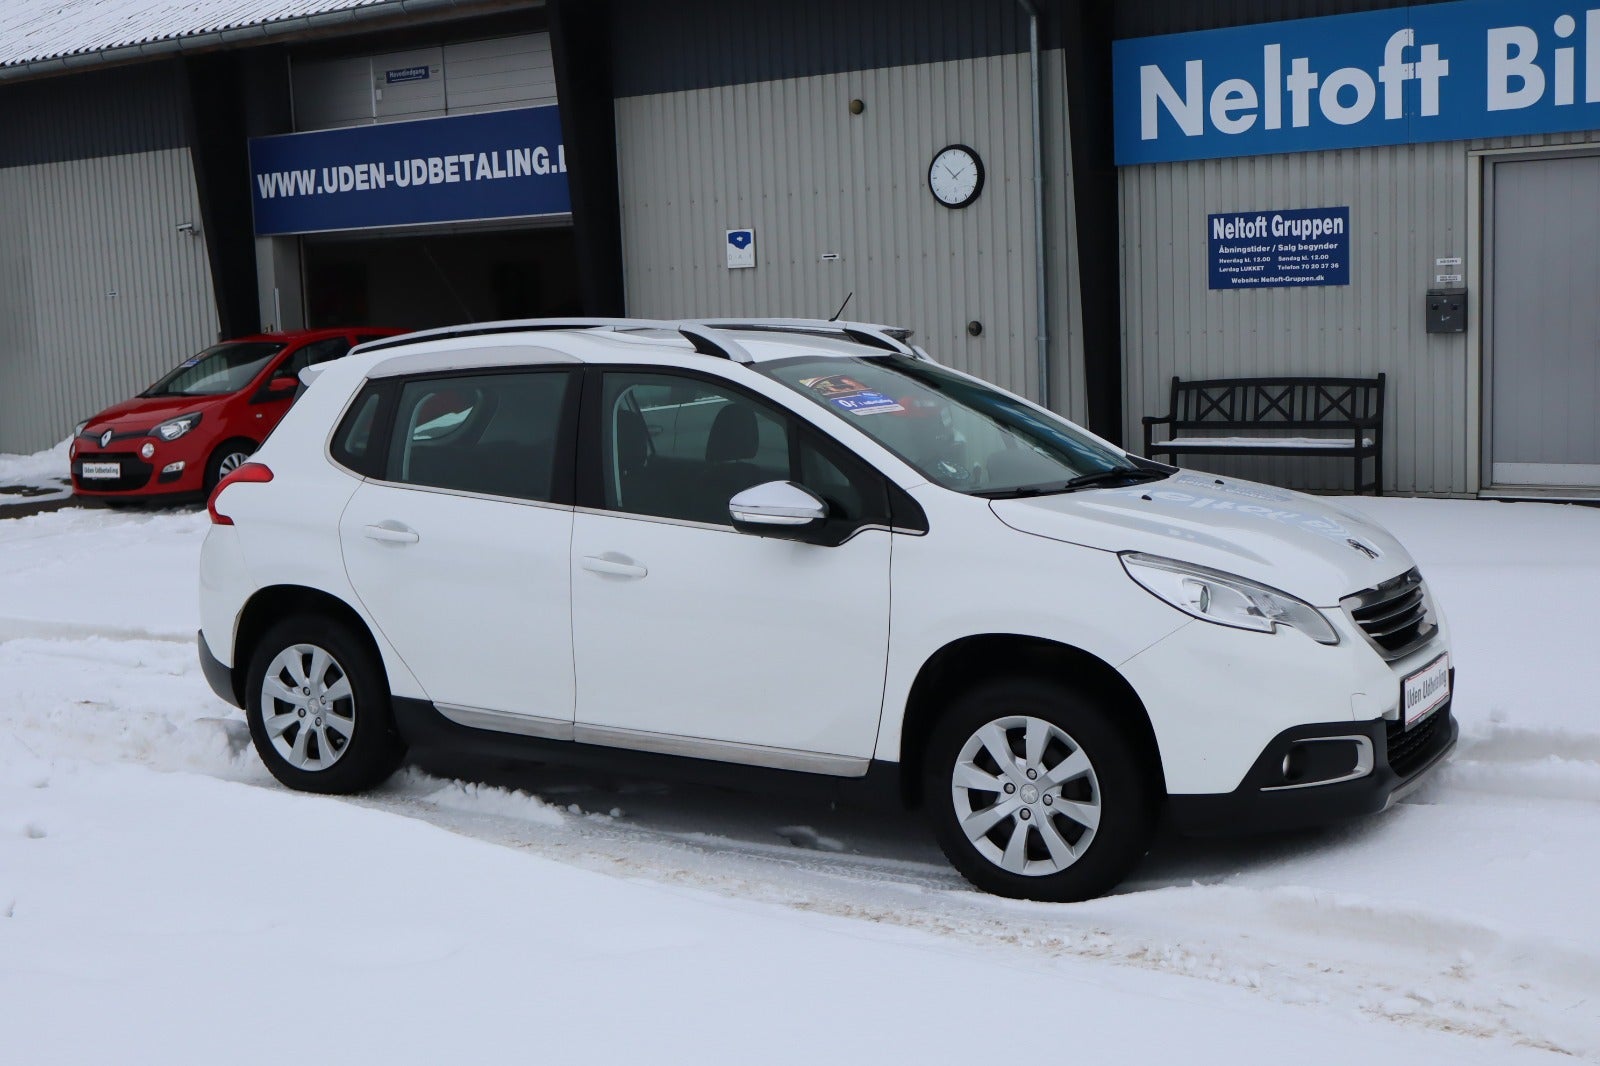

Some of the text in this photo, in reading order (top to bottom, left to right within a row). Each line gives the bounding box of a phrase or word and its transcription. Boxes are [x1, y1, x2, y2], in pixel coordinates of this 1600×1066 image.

[1140, 9, 1600, 140] Neltoft Bil
[1213, 215, 1343, 240] Neltoft Gruppen
[1218, 243, 1338, 254] Åbningstider / Salg begynder
[1260, 275, 1325, 284] Neltoft-Gruppen.dk
[1406, 688, 1422, 709] Uden
